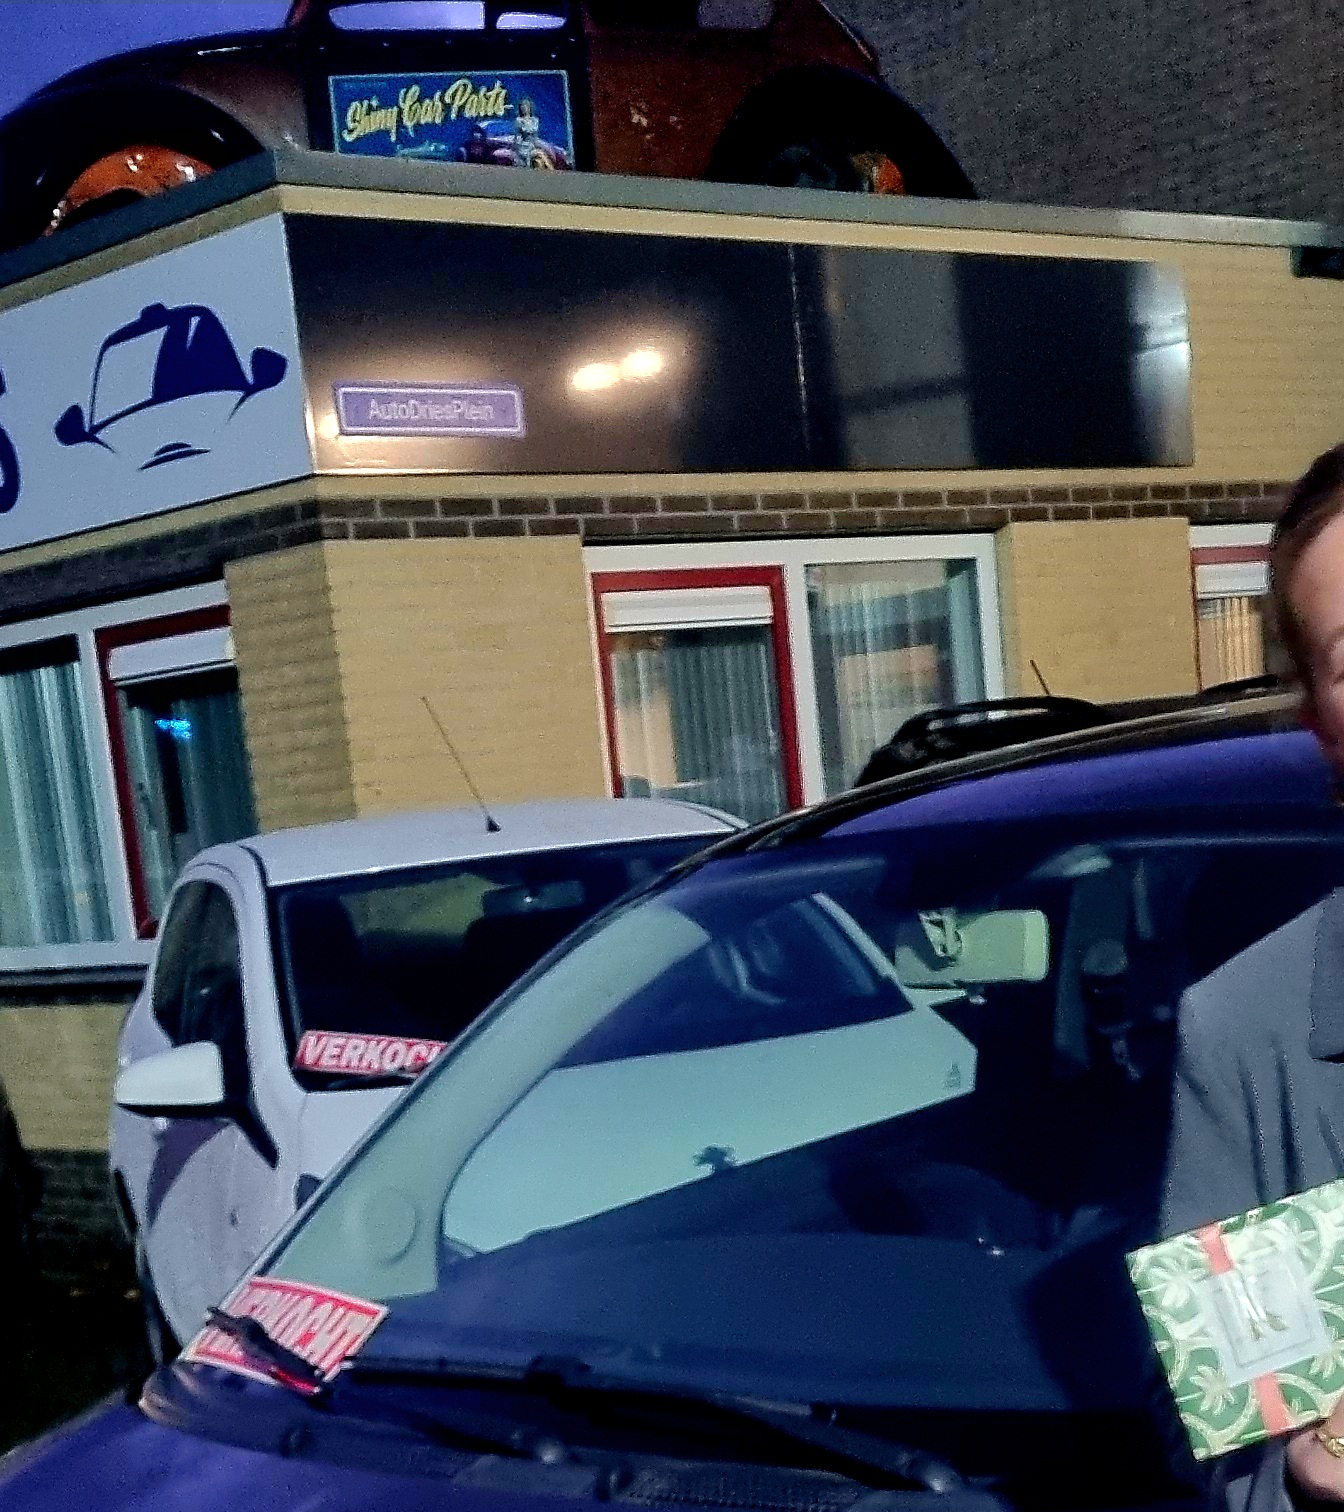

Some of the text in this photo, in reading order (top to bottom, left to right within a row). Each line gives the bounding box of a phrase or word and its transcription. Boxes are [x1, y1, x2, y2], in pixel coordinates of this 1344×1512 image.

[342, 78, 514, 143] Shiny Car Parts
